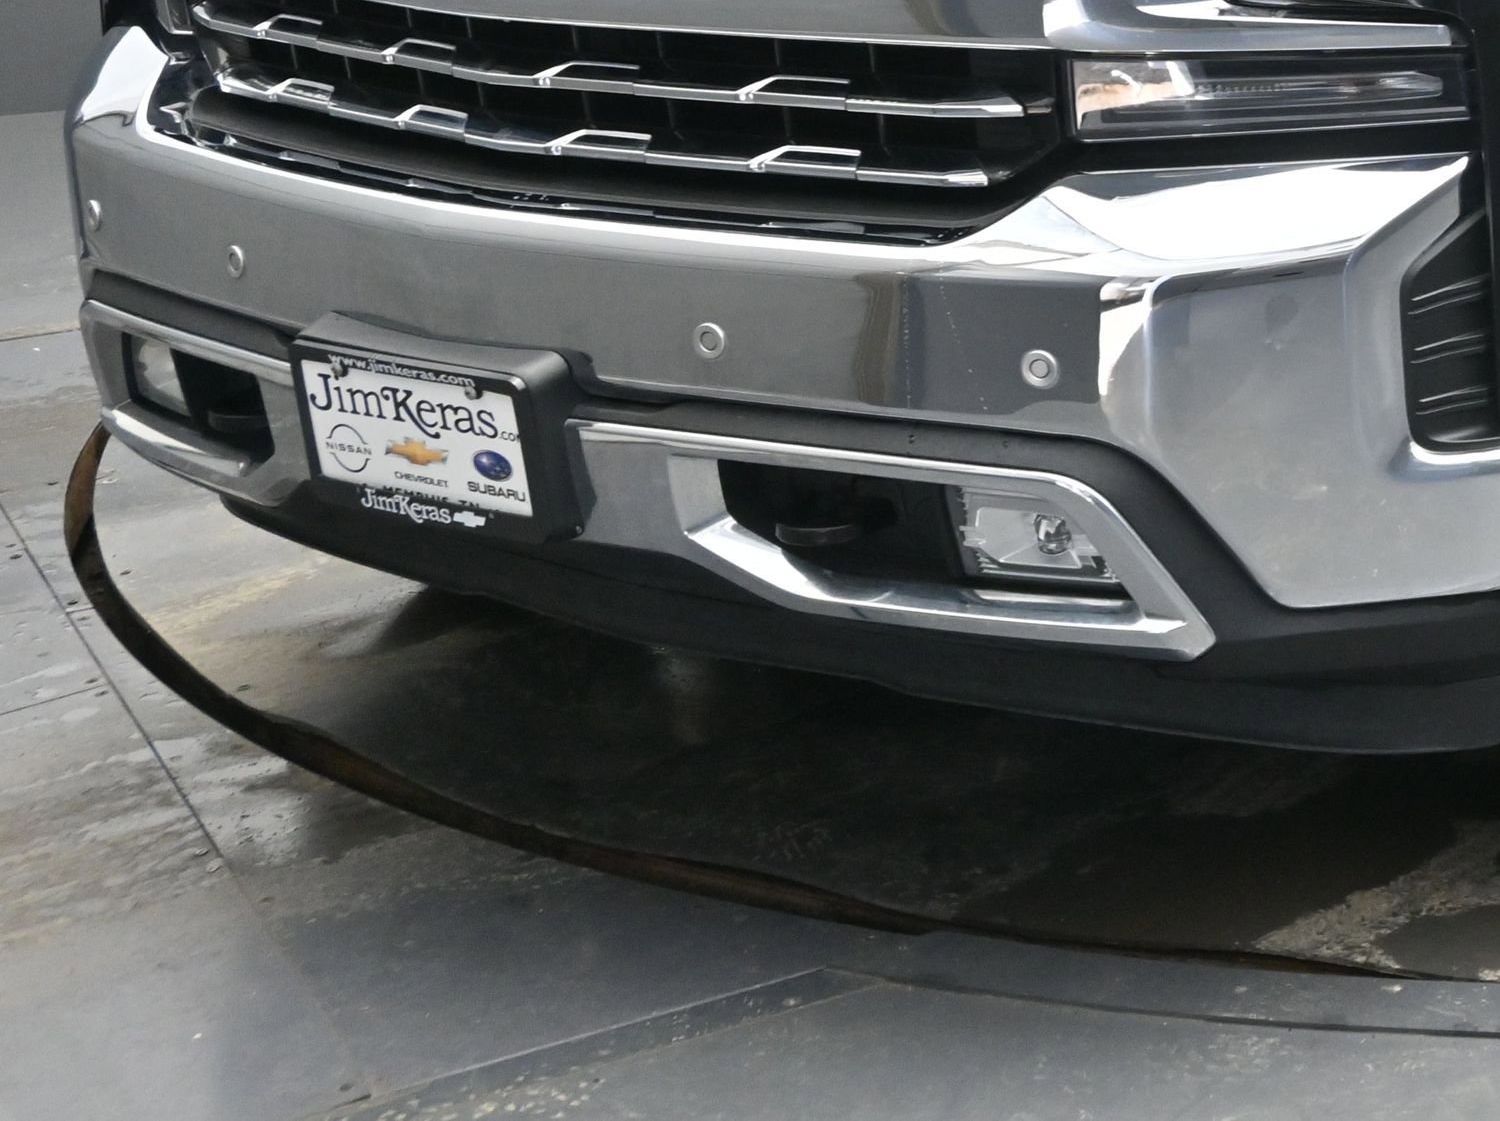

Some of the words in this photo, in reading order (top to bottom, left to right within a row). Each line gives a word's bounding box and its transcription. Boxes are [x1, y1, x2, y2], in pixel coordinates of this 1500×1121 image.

[328, 354, 476, 387] www.jimkeras.com
[325, 441, 372, 456] NISSAN
[394, 471, 448, 489] CHEVROLET
[467, 481, 526, 502] SUBARU
